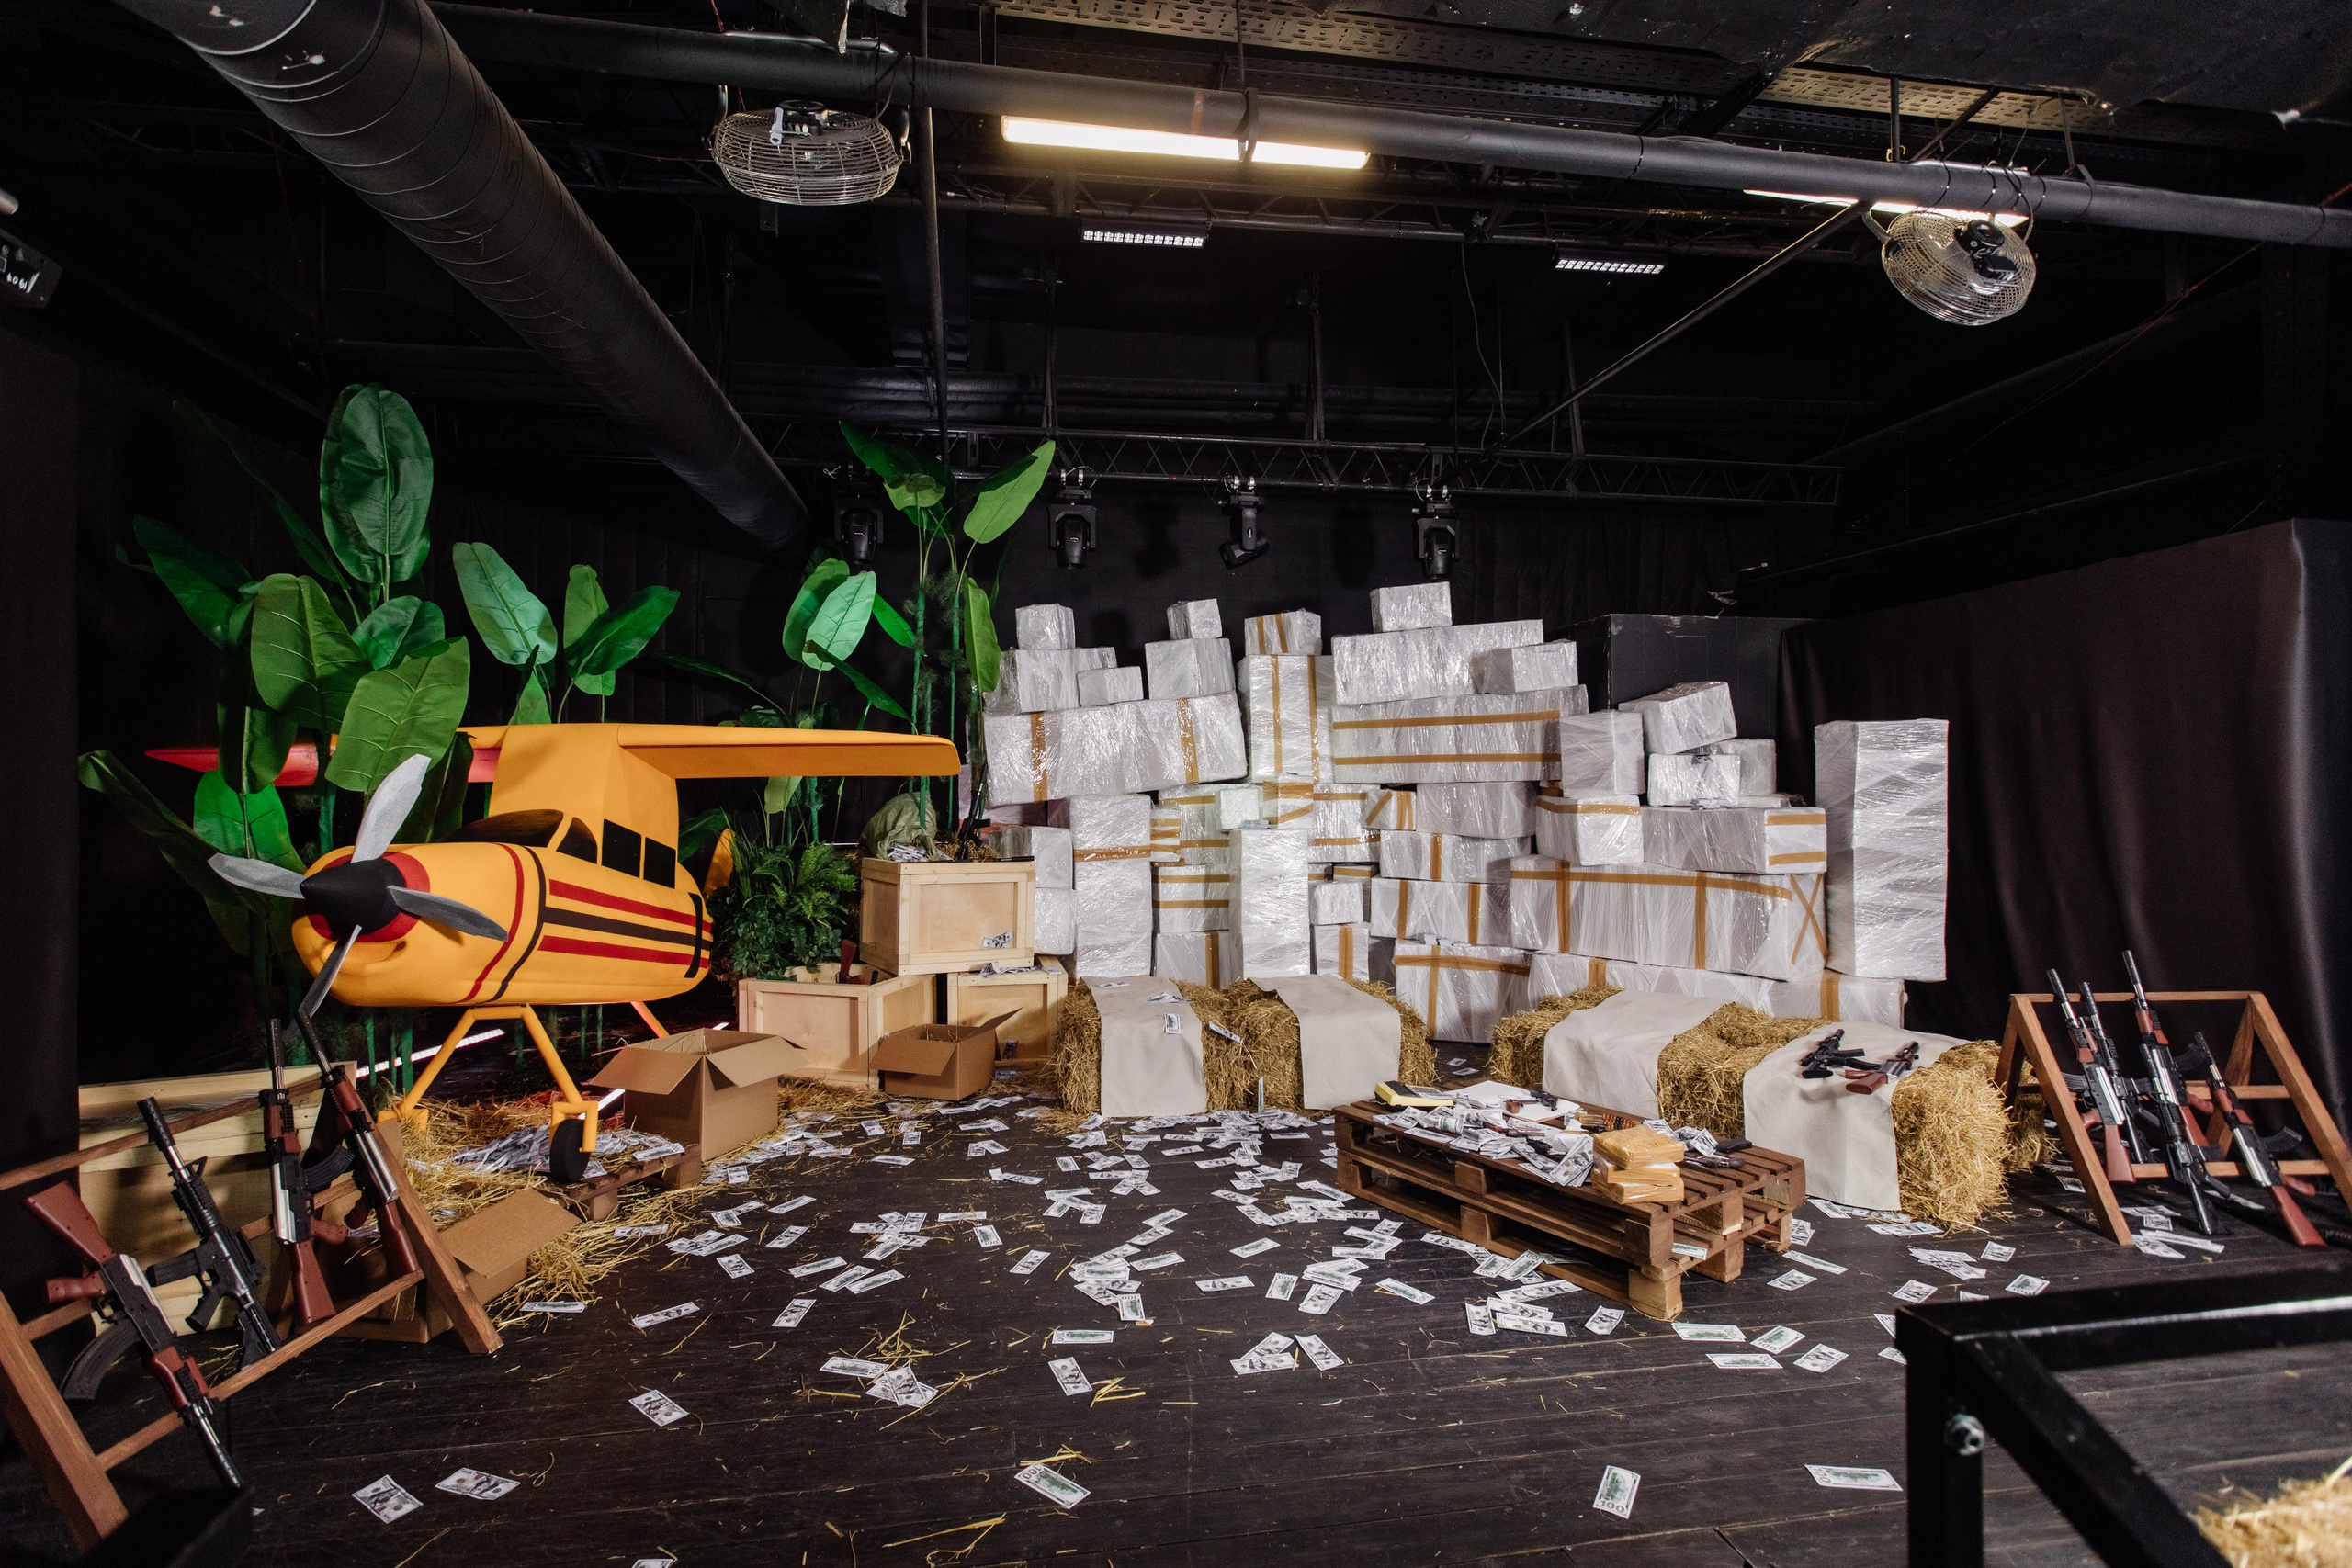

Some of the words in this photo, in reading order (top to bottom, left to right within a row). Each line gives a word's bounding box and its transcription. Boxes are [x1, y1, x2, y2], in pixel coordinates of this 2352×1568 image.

[1758, 1341, 1777, 1350] 100
[869, 1364, 882, 1375] 100
[1023, 1467, 1042, 1479] 100
[1814, 1469, 1831, 1483] 100
[1600, 1500, 1624, 1513] 100
